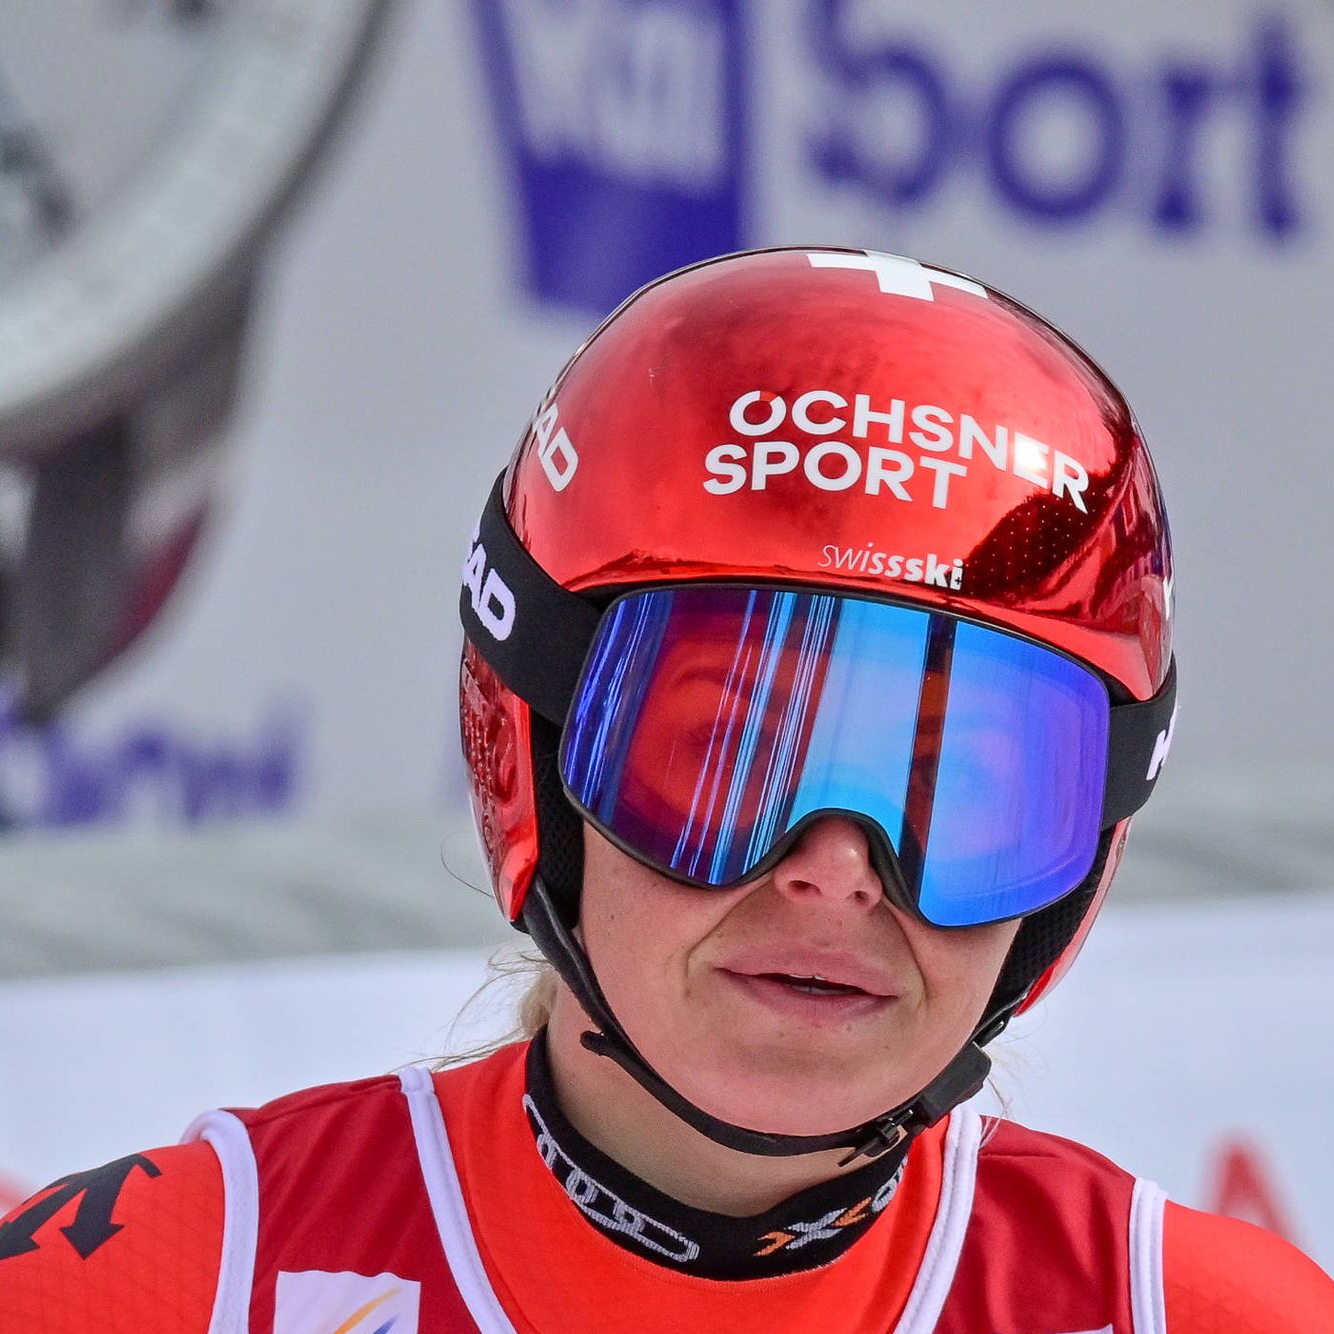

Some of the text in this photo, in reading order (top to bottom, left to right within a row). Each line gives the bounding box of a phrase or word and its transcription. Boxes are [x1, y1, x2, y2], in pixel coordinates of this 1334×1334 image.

[533, 403, 579, 492] AD
[702, 440, 968, 510] SPORT
[729, 389, 1090, 515] OCHSNER
[464, 542, 517, 641] AD
[817, 542, 965, 590] swissski
